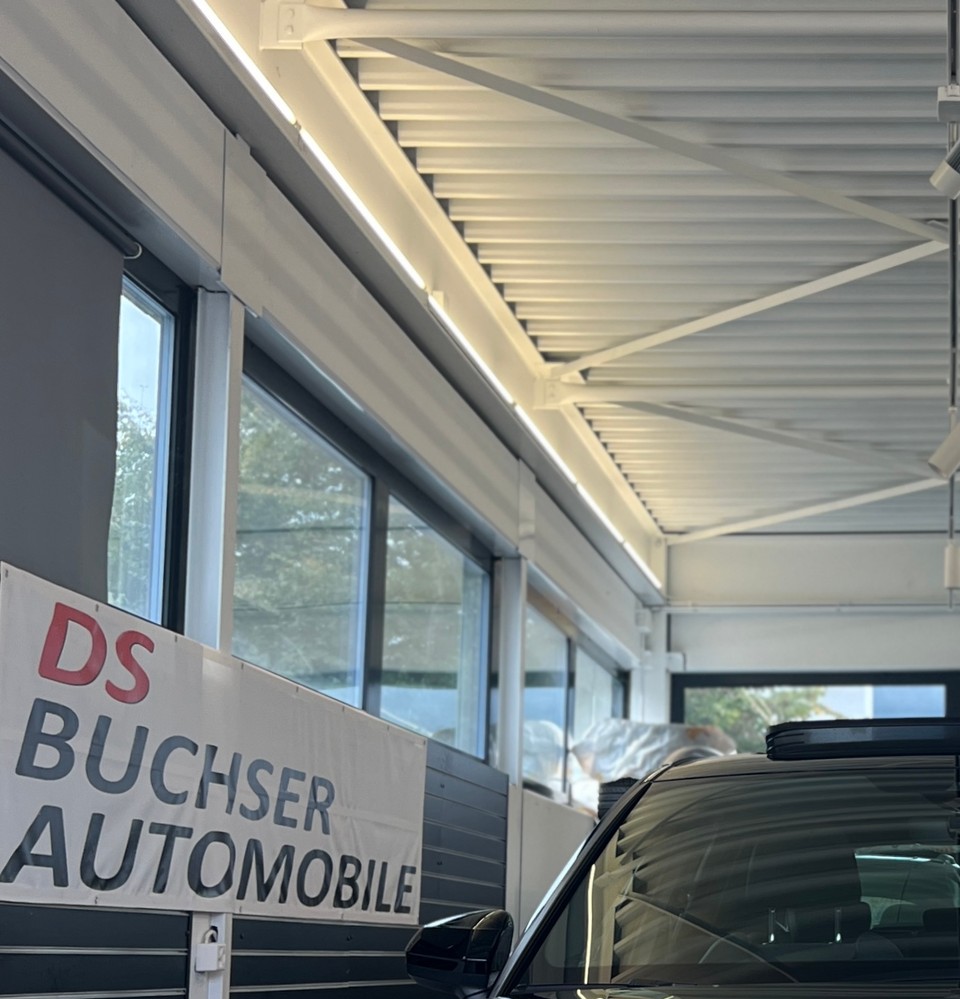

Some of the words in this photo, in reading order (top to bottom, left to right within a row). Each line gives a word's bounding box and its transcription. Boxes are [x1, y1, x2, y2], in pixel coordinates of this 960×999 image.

[38, 602, 155, 704] DS
[15, 697, 336, 835] BUCHSER
[0, 805, 417, 914] AUTOMOBILE
